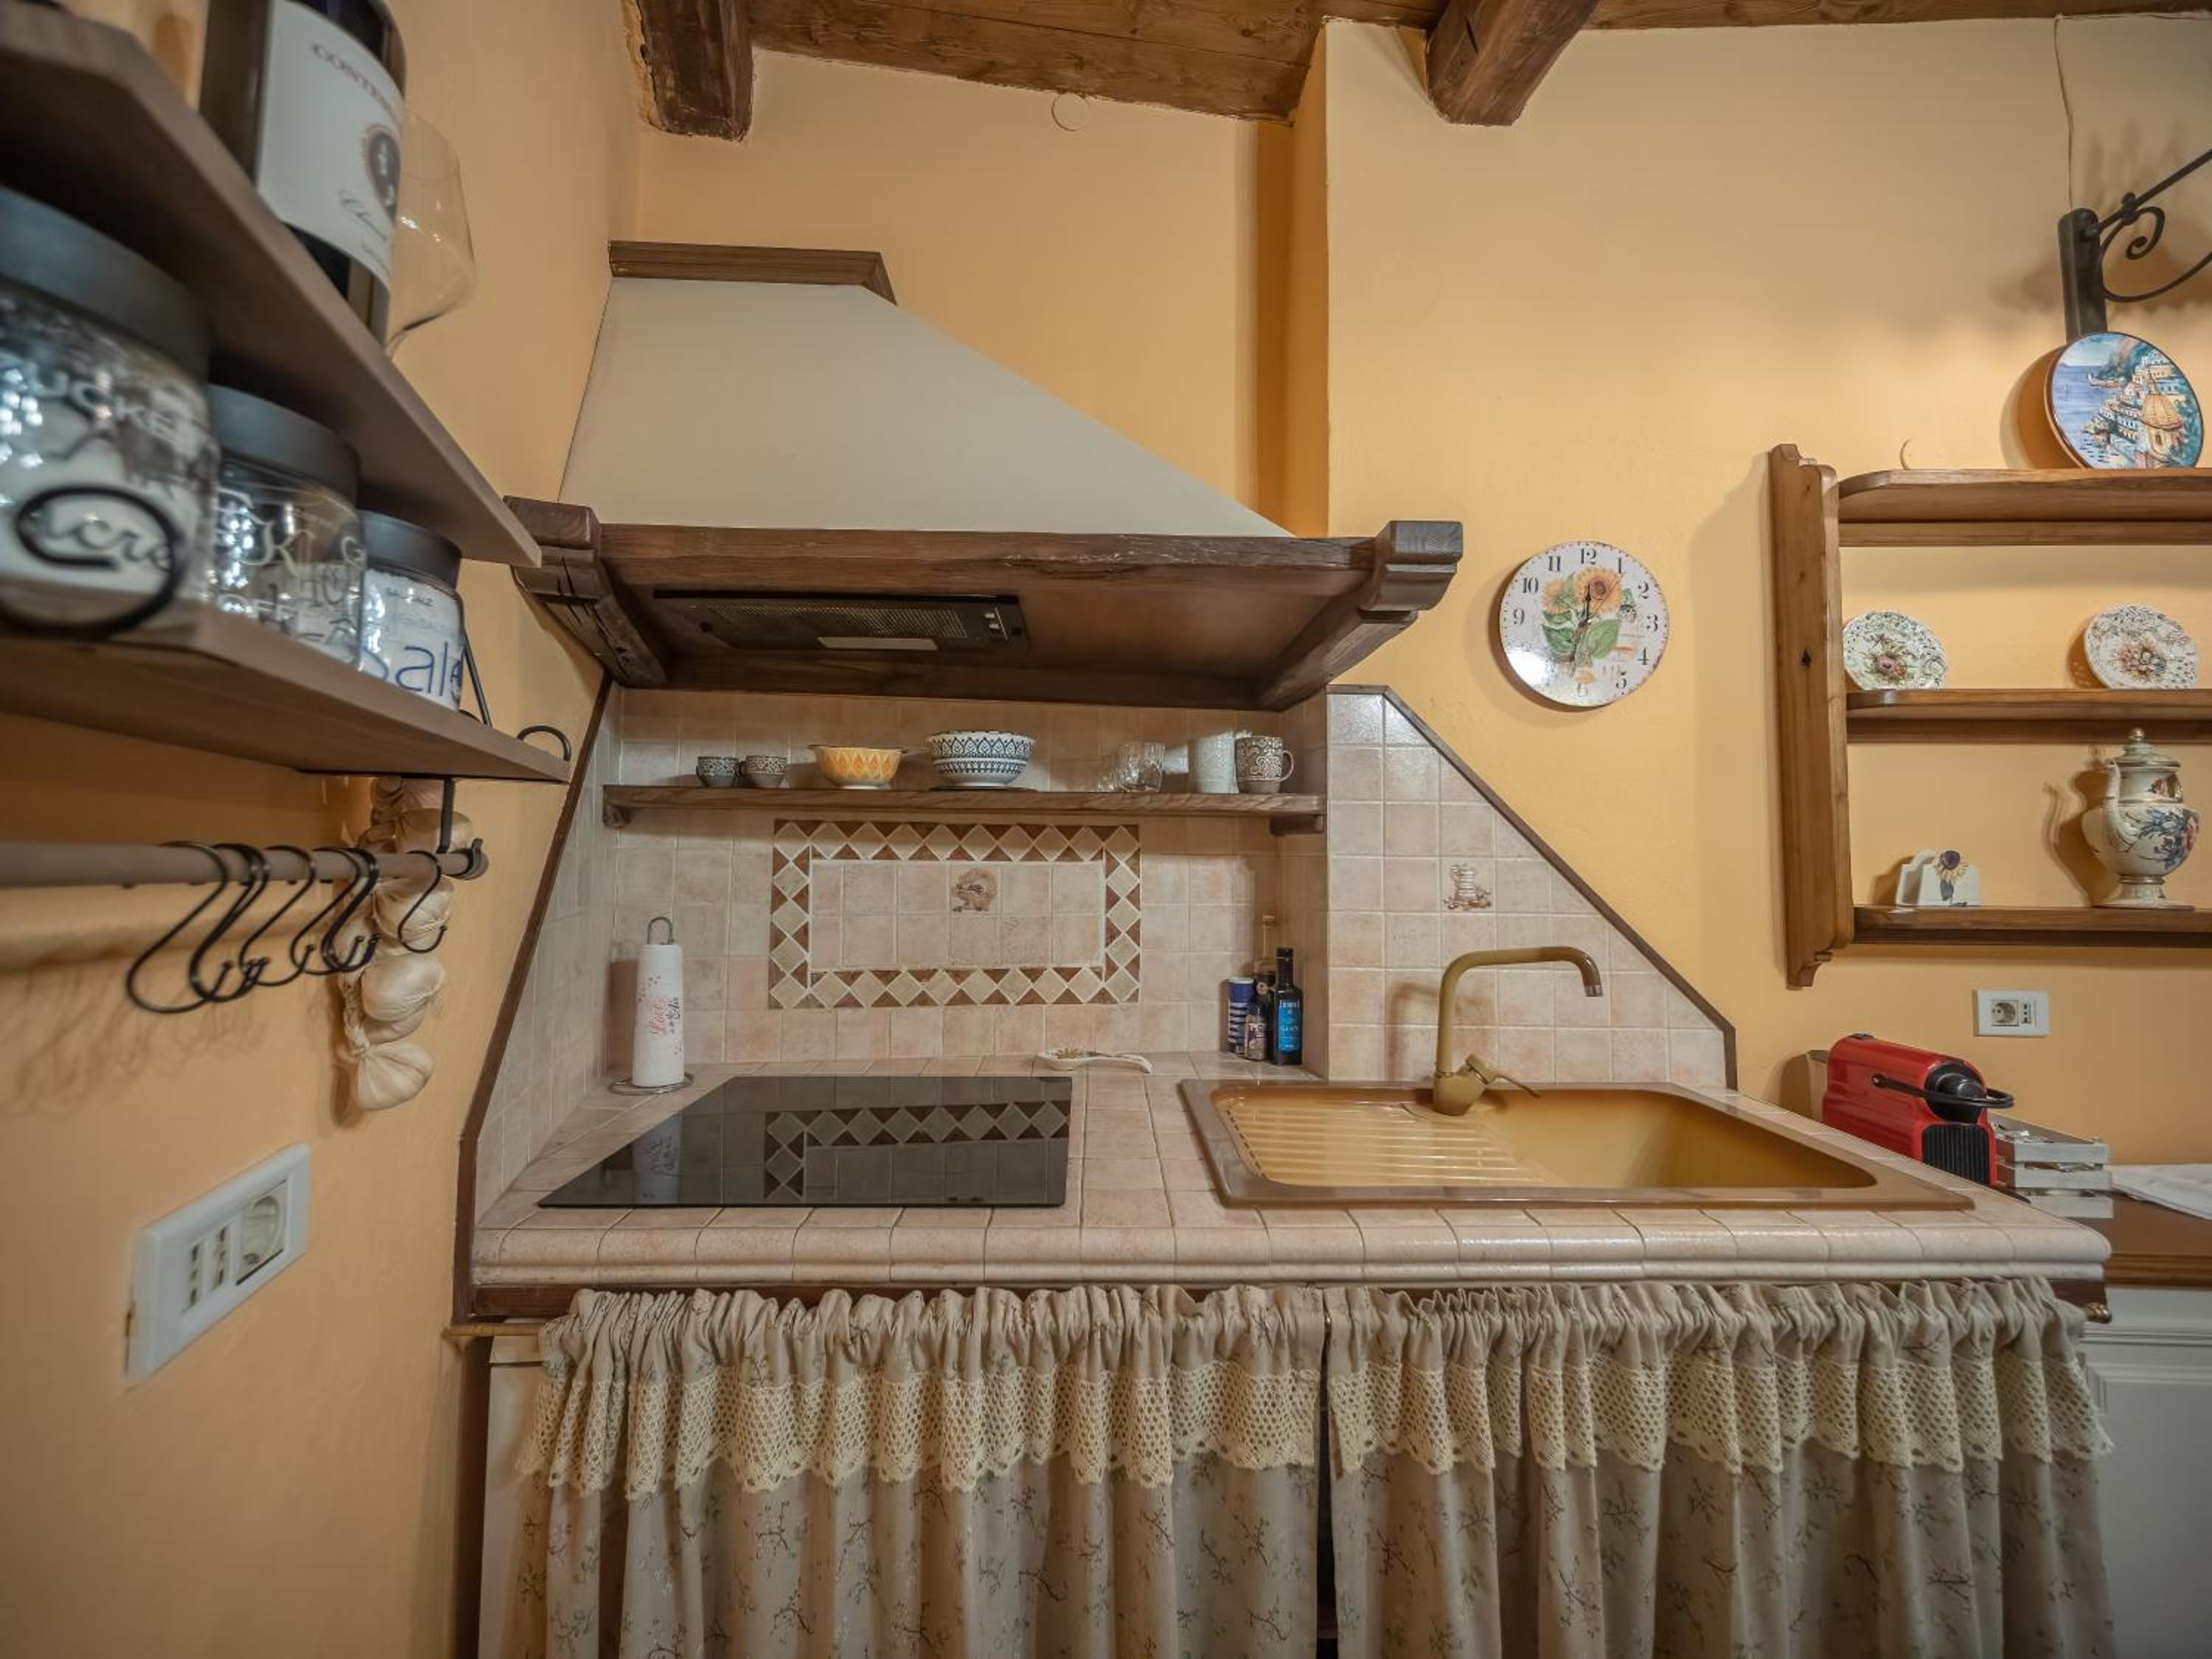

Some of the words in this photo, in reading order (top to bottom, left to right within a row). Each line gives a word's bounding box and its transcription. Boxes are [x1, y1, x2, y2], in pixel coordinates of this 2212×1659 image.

[1548, 556, 1561, 571] 11
[1580, 549, 1597, 565] 12
[1618, 557, 1624, 574] 1
[1523, 578, 1539, 594] 10
[1638, 580, 1649, 599] 2
[1513, 609, 1525, 625] 9
[1646, 613, 1658, 632] 3
[1637, 647, 1649, 665] 4
[1615, 672, 1627, 689] 5
